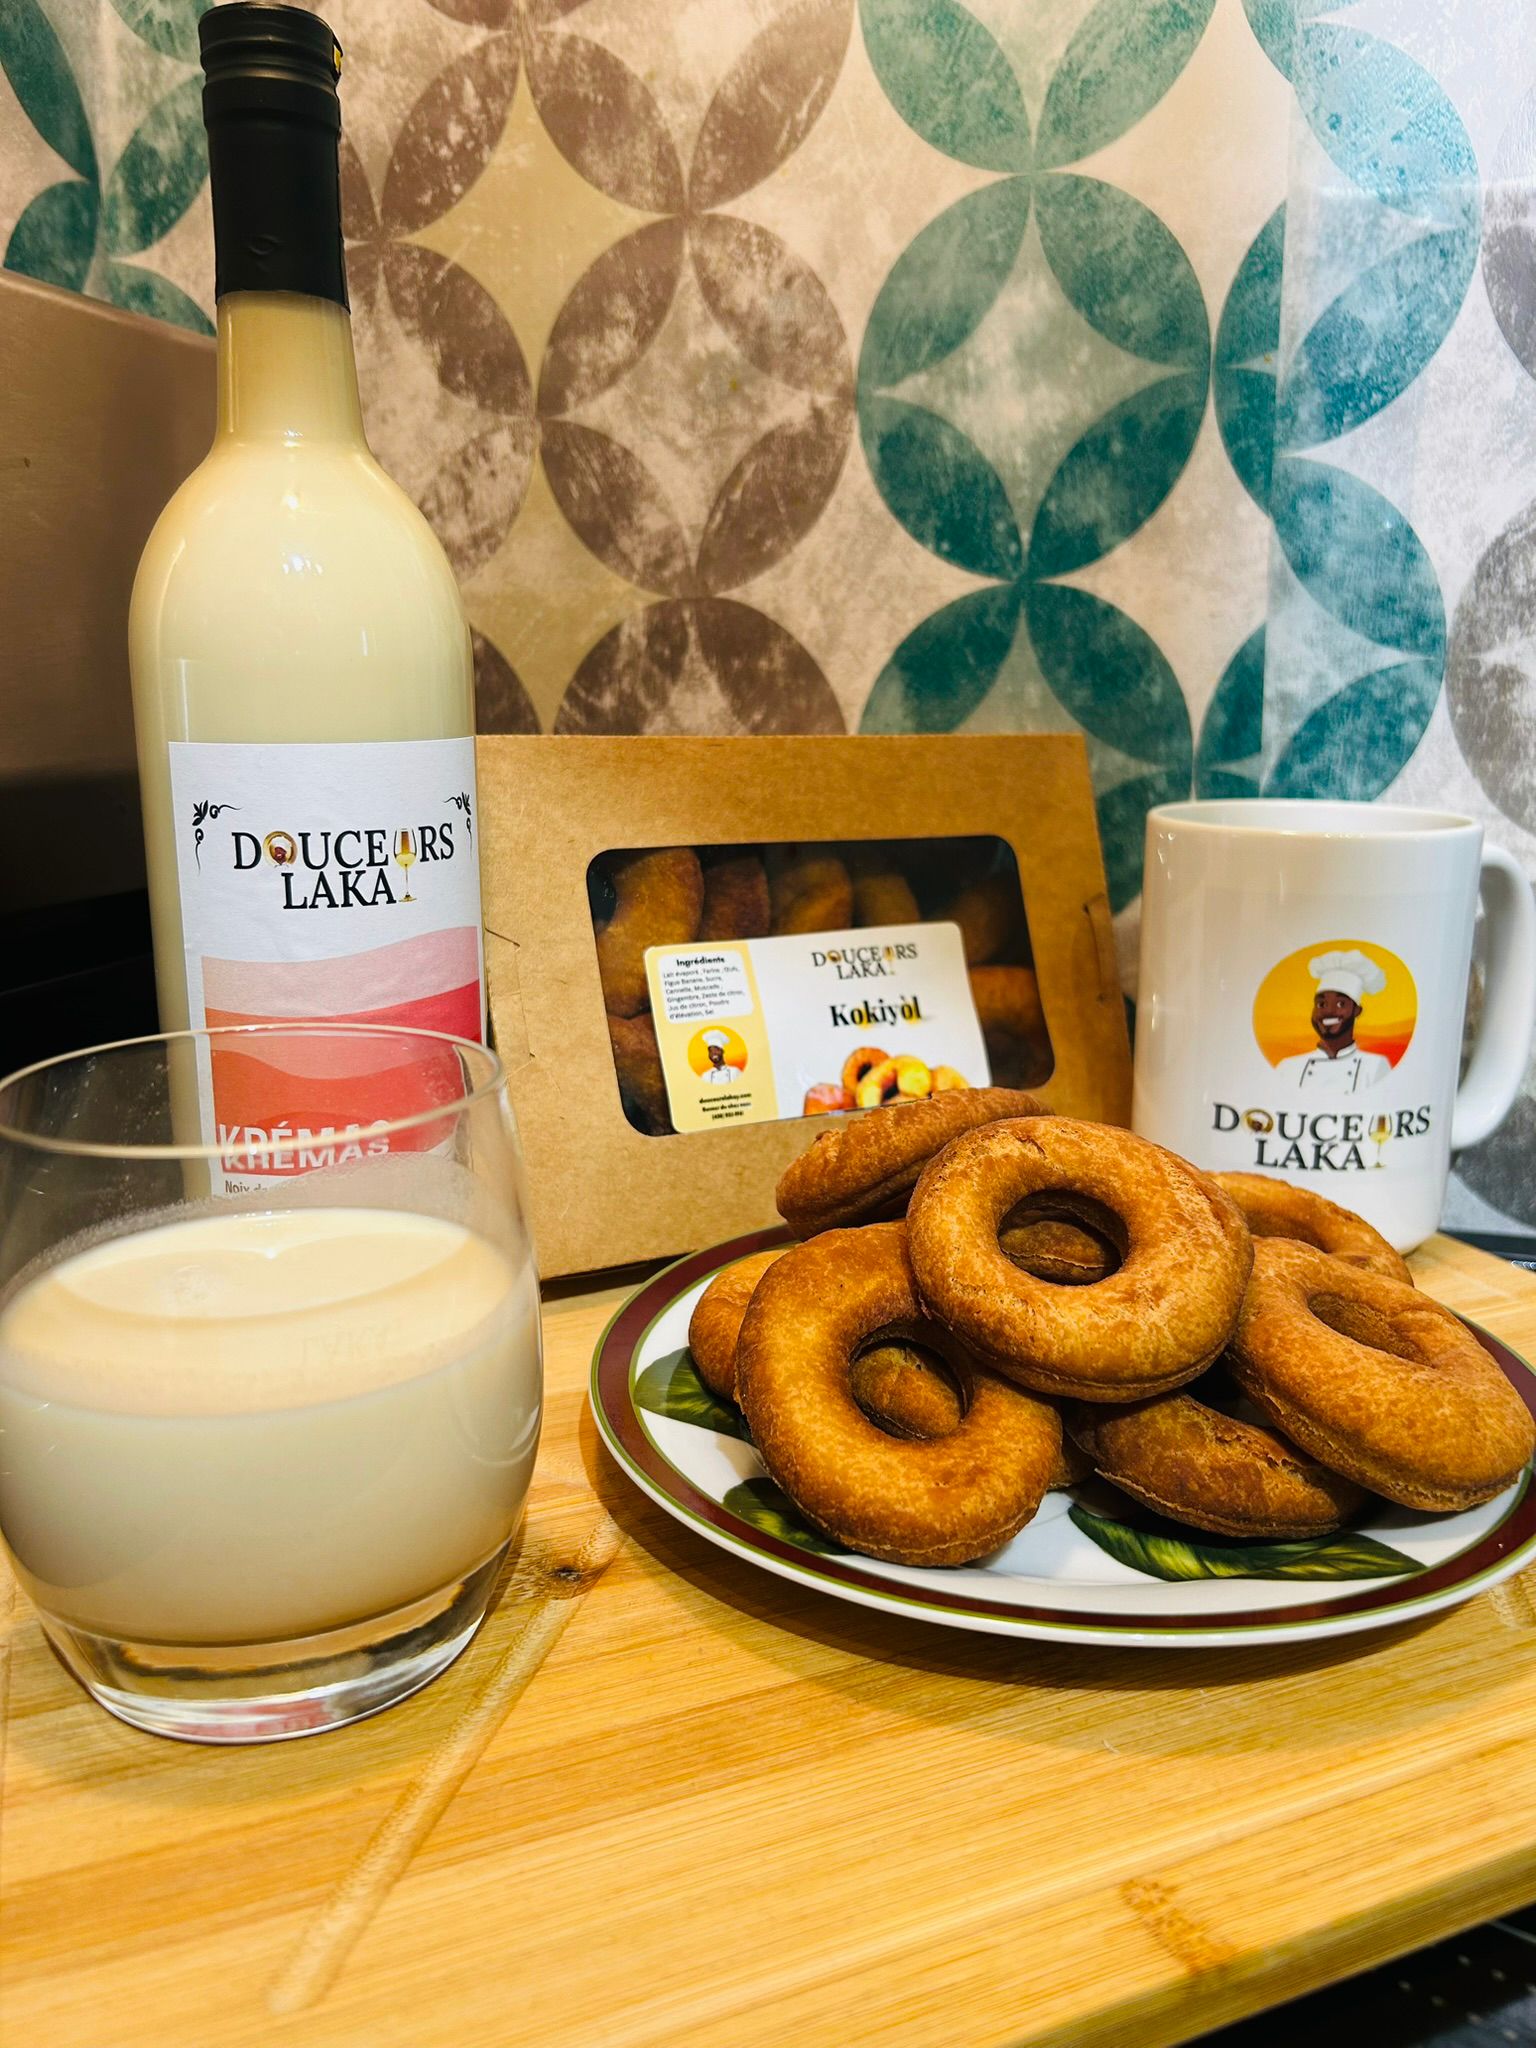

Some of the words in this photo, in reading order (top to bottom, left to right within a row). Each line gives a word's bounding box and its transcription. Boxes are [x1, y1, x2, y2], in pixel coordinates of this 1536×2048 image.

[231, 822, 454, 871] DOUCEURS
[812, 944, 918, 967] DOUCEURS
[829, 994, 922, 1027] Kokiyòl
[1211, 1102, 1431, 1144] DOUCEURS
